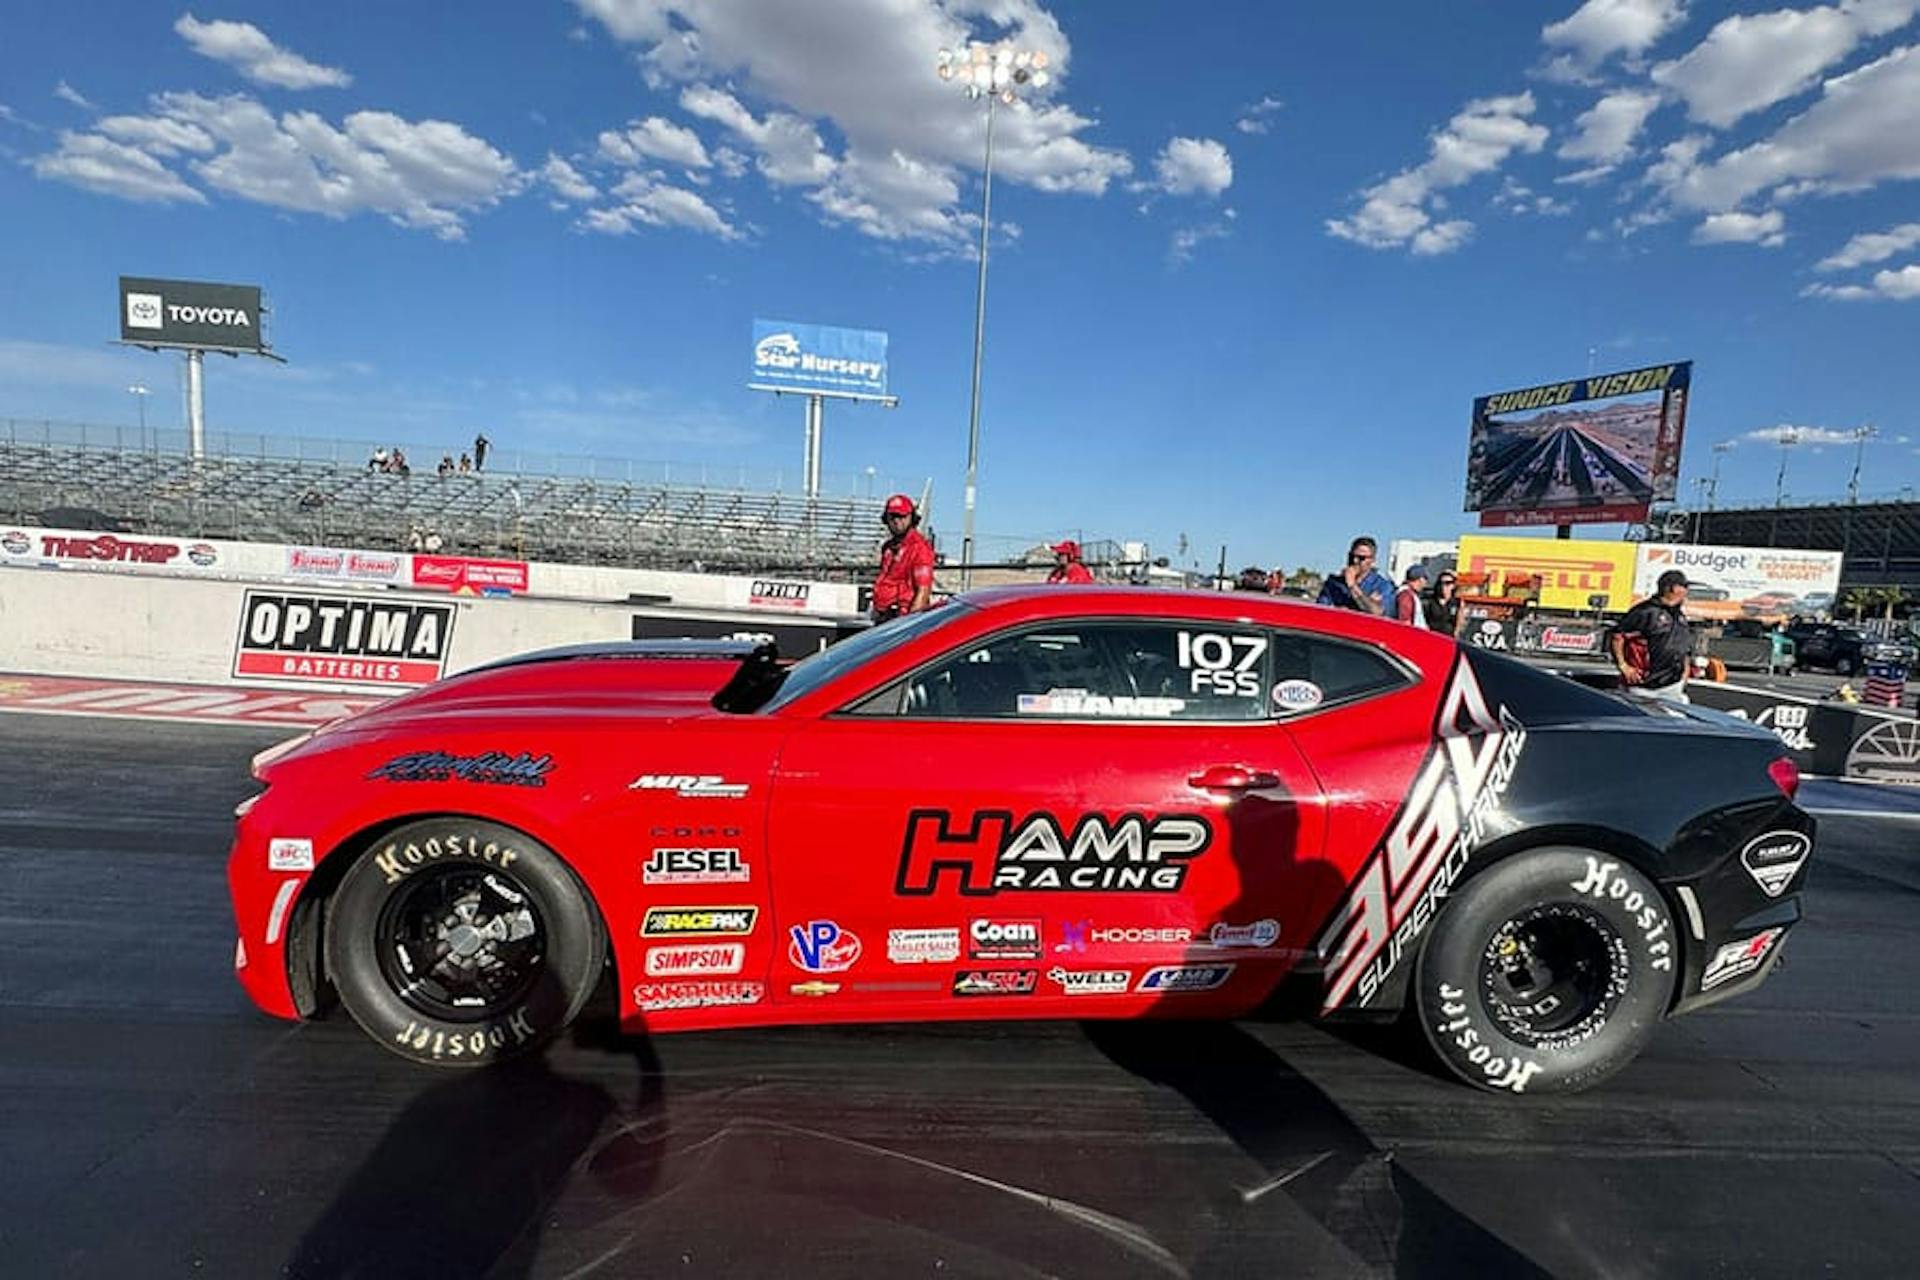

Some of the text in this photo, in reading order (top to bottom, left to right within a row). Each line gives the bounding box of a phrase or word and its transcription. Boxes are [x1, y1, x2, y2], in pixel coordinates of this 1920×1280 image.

[168, 304, 249, 326] TOYOTA
[801, 354, 881, 378] Nursery
[1484, 365, 1675, 416] SUNOCO VISION
[1674, 550, 1747, 572] Budget
[752, 581, 810, 599] OPTIMA
[250, 603, 439, 654] OPTIMA
[1177, 632, 1267, 671] 107
[283, 658, 400, 678] BATTERIES
[1191, 671, 1259, 696] FSS
[374, 835, 519, 884] Hoosier
[646, 851, 742, 872] JESEL
[897, 810, 1213, 895] HAMP
[995, 867, 1180, 888] RACING
[664, 912, 749, 930] RACEPAK
[1570, 856, 1672, 973] Hoosier
[971, 919, 1037, 942] Coan
[1091, 929, 1192, 942] HOOSIER
[794, 924, 838, 969] VP
[654, 948, 734, 970] SIMPSON
[1066, 972, 1127, 984] WELD
[396, 1006, 535, 1060] Hoosier
[1437, 983, 1544, 1093] Hoosier
